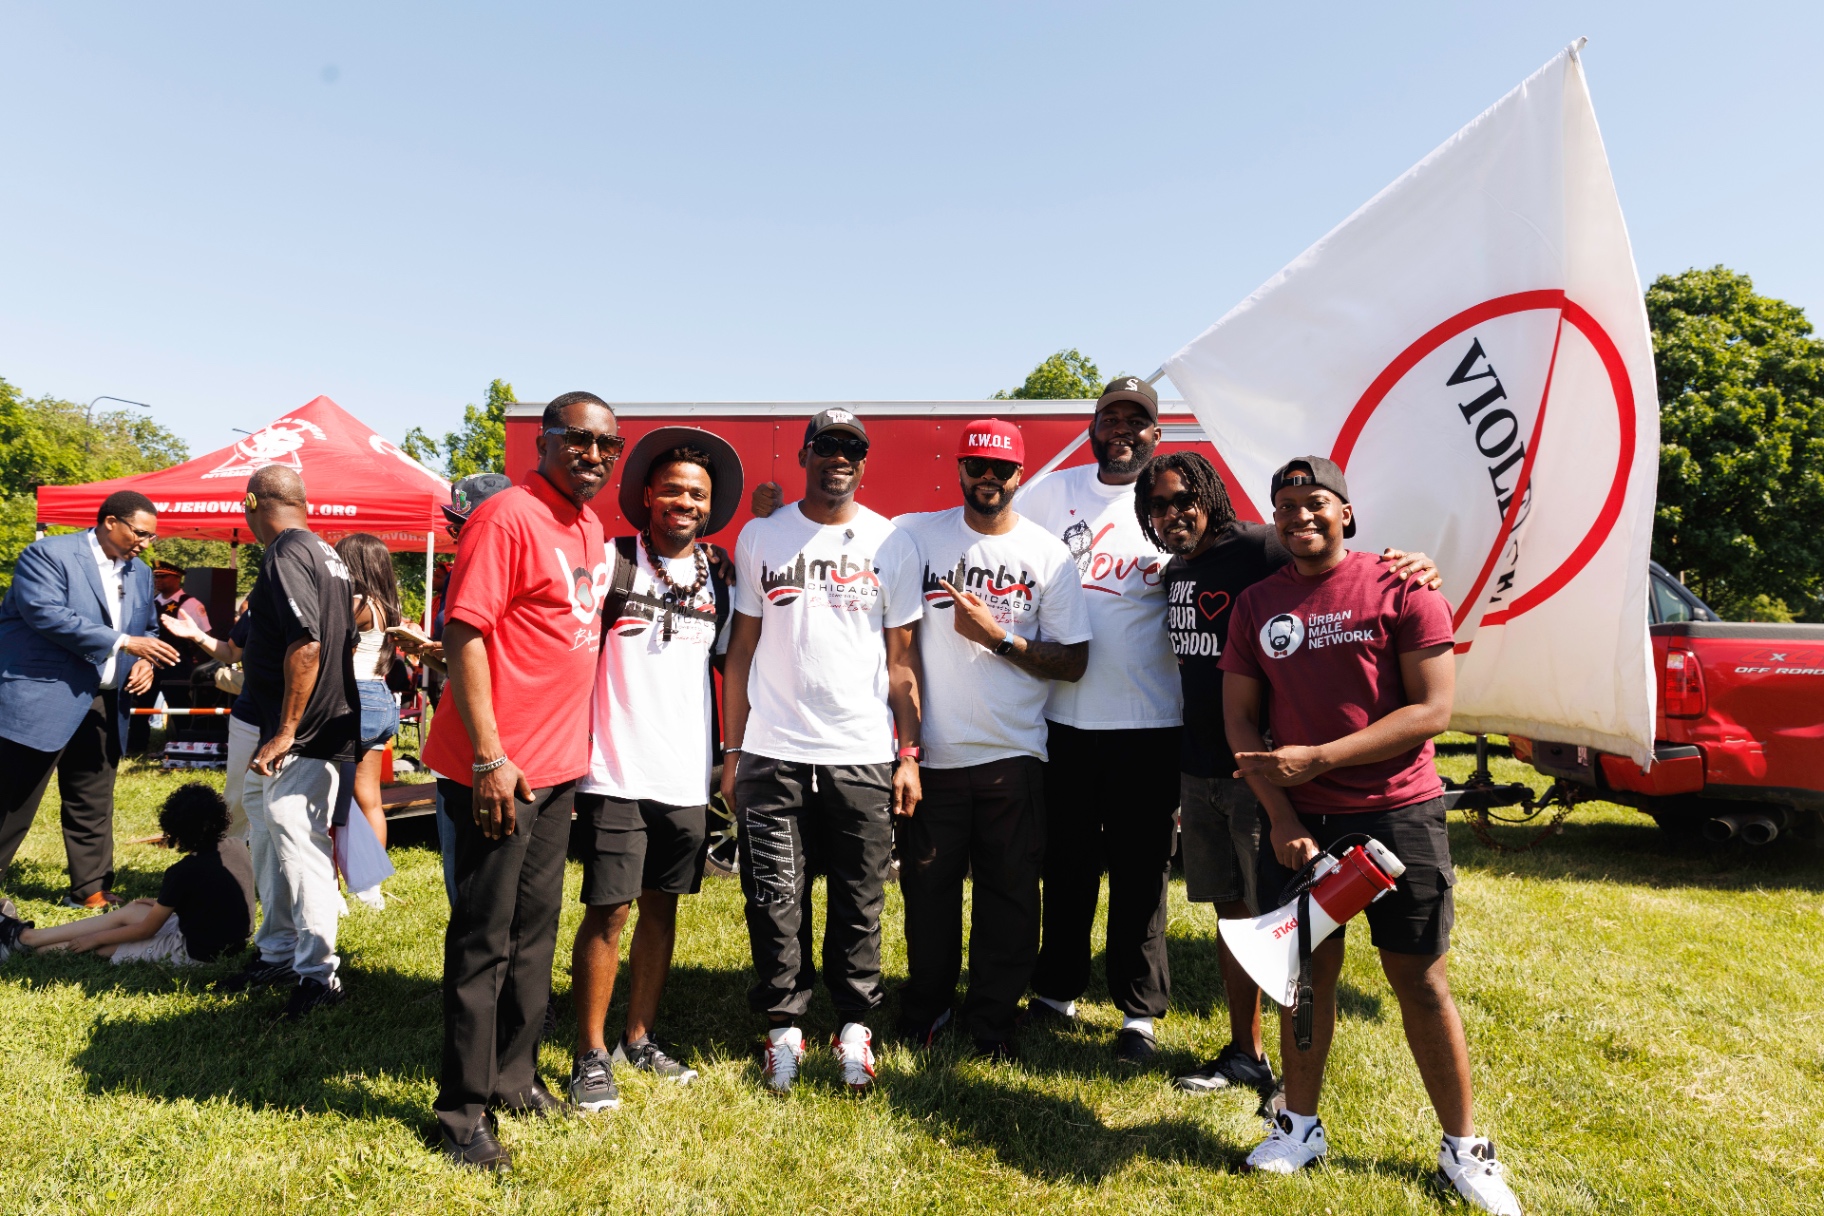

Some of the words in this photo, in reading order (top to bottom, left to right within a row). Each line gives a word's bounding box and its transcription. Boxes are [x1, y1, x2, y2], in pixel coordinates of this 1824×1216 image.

[807, 583, 878, 597] CHICAGO
[966, 565, 1036, 601] mbk
[1168, 606, 1197, 630] OUR
[1308, 609, 1352, 627] URBAN
[1308, 621, 1342, 638] MALE
[1308, 629, 1374, 650] NETWORK
[1169, 632, 1222, 657] CHOOL
[1734, 666, 1771, 674] OFF
[1775, 667, 1824, 676] ROAD
[1272, 917, 1299, 940] PYLE
